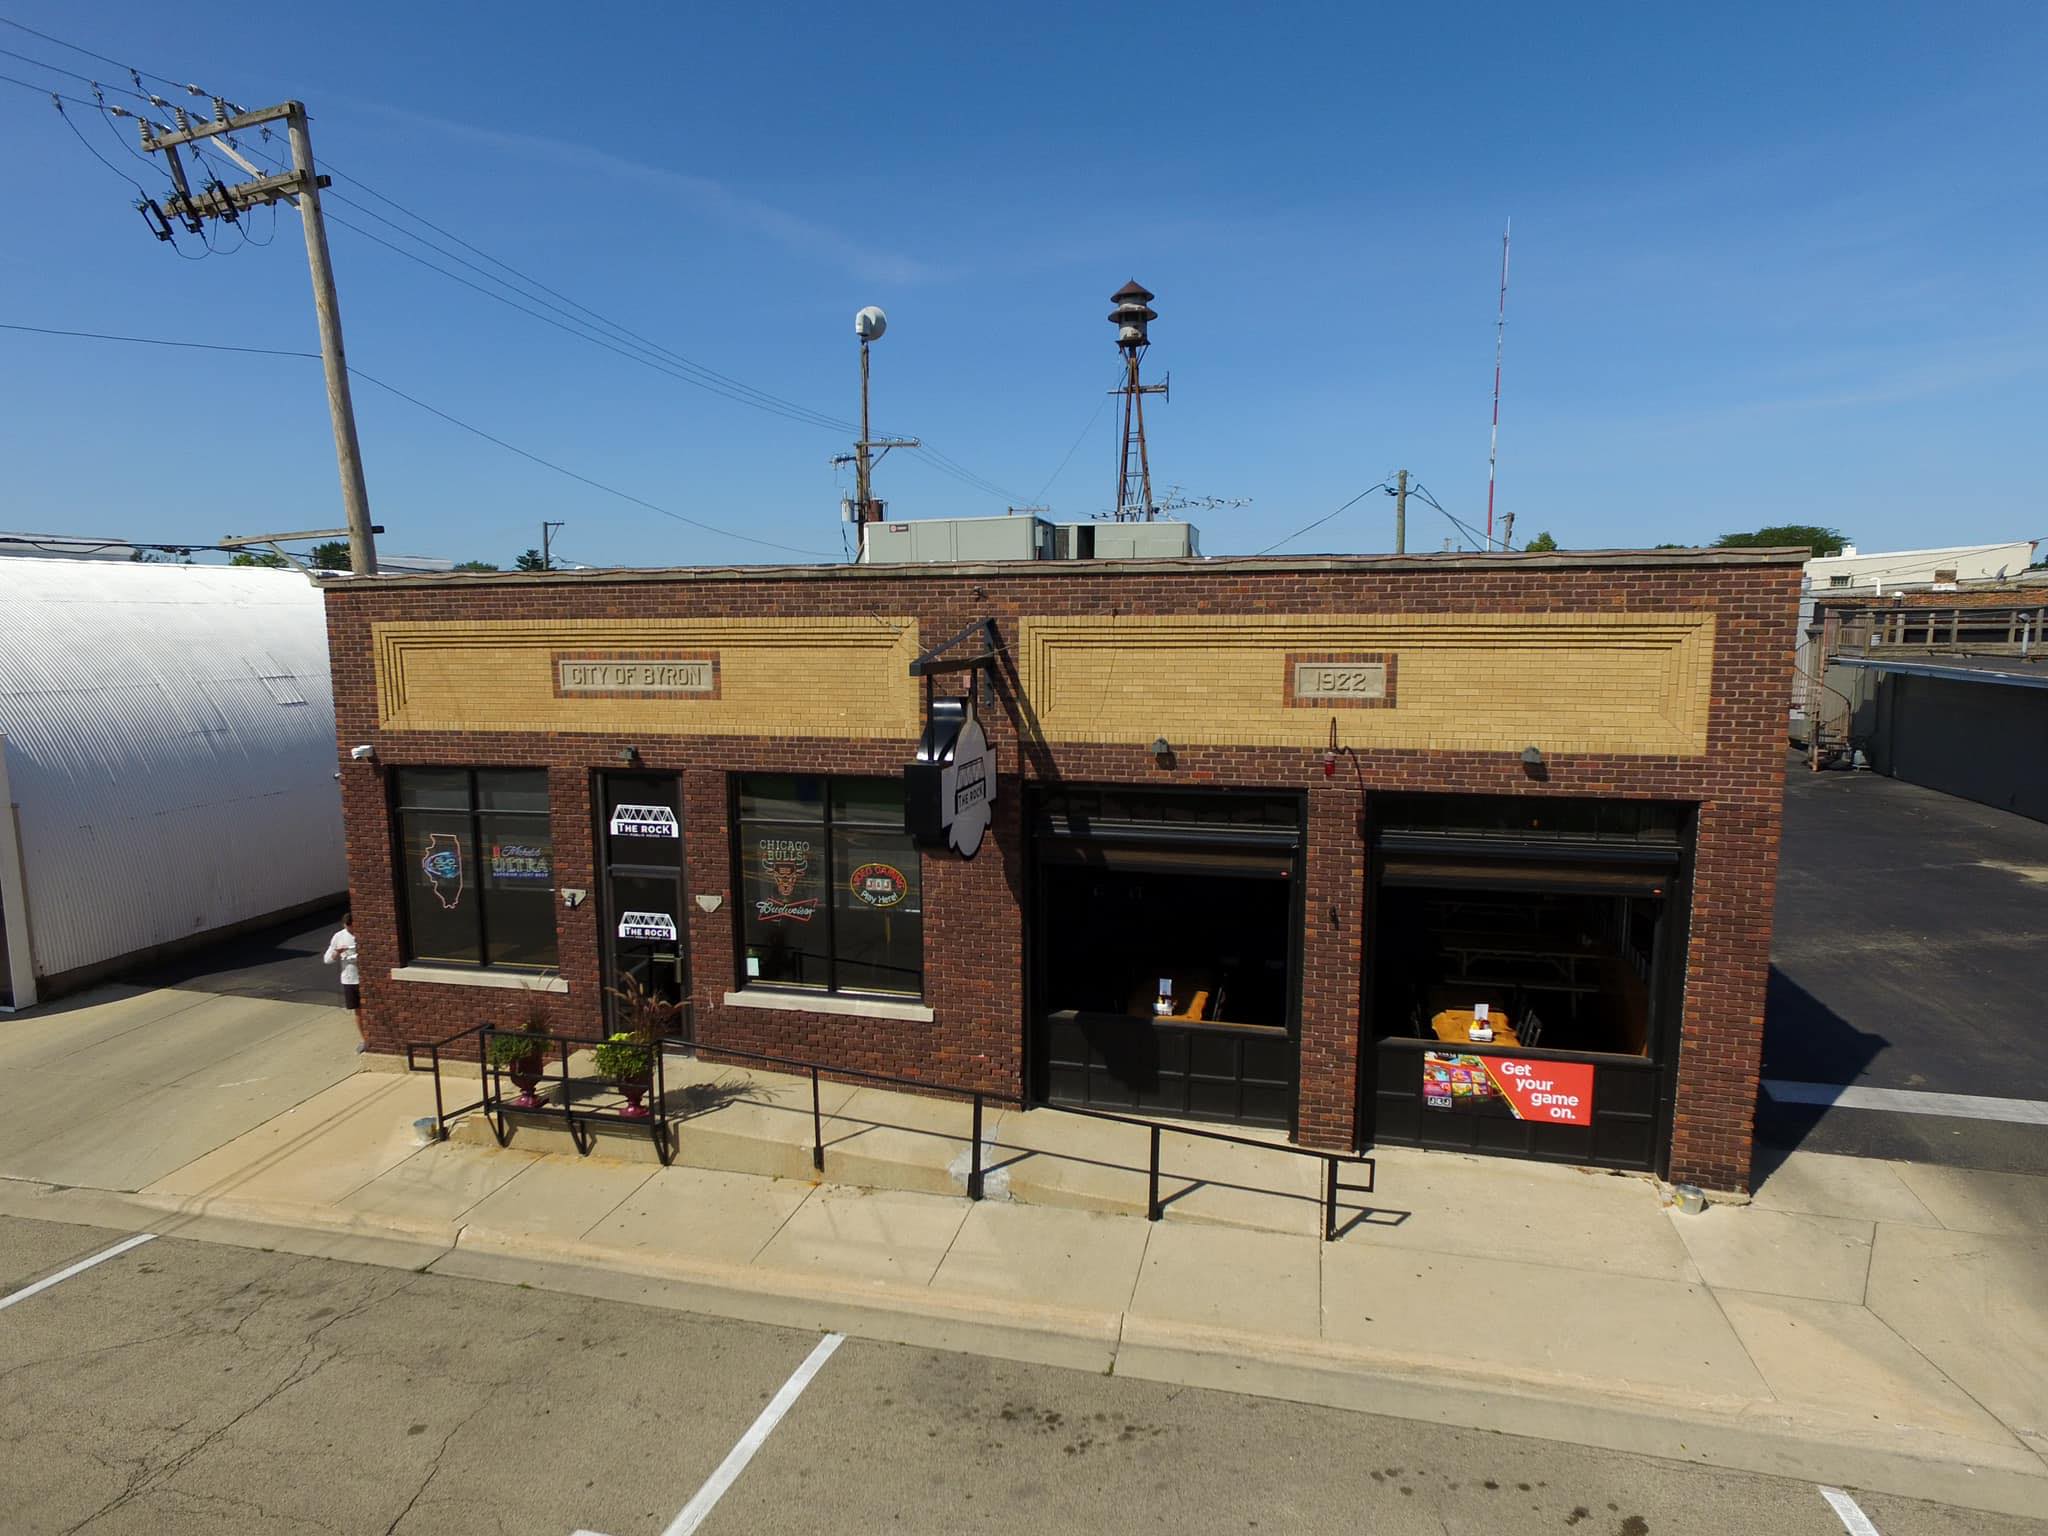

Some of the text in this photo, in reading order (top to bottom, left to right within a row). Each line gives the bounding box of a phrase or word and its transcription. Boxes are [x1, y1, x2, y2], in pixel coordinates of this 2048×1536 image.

[572, 667, 701, 686] CITY OF BYRON
[1316, 672, 1366, 692] 1922
[958, 792, 969, 809] THE
[618, 823, 671, 834] THE ROCK
[760, 840, 810, 851] CHICAGO
[767, 850, 804, 861] BULLS
[491, 857, 549, 873] ULTRA
[860, 890, 877, 904] Play
[756, 901, 815, 915] Budweiser
[625, 927, 669, 937] THE ROCK
[1501, 1062, 1532, 1076] Get
[1516, 1078, 1553, 1092] your
[1531, 1092, 1579, 1106] game
[1550, 1107, 1576, 1119] on.
